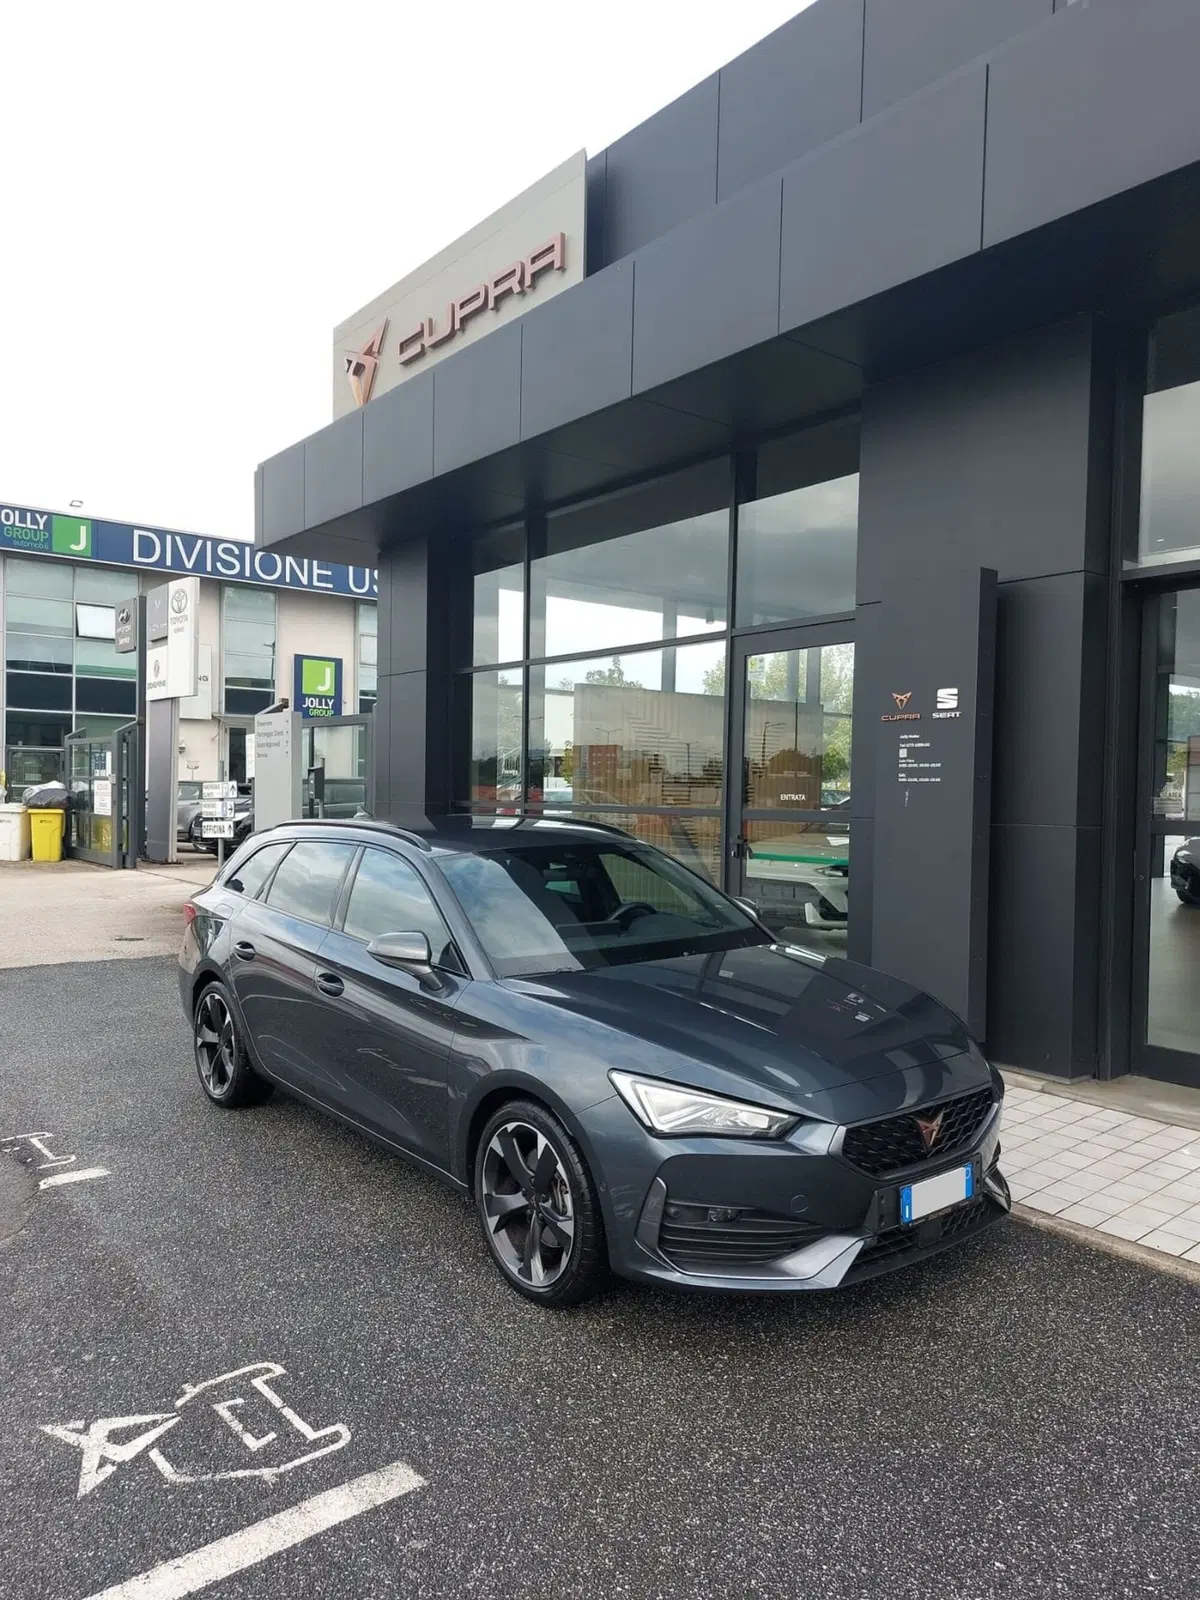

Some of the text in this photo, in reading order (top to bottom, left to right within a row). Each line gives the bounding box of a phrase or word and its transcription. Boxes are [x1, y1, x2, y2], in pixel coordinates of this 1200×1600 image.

[397, 231, 566, 366] CUPRA
[4, 526, 49, 542] GROUP
[133, 529, 378, 593] DIVISIONE U
[302, 697, 335, 709] JOLLY
[309, 708, 334, 717] GROUP
[881, 713, 921, 721] CUPRA
[932, 711, 962, 719] SEAT
